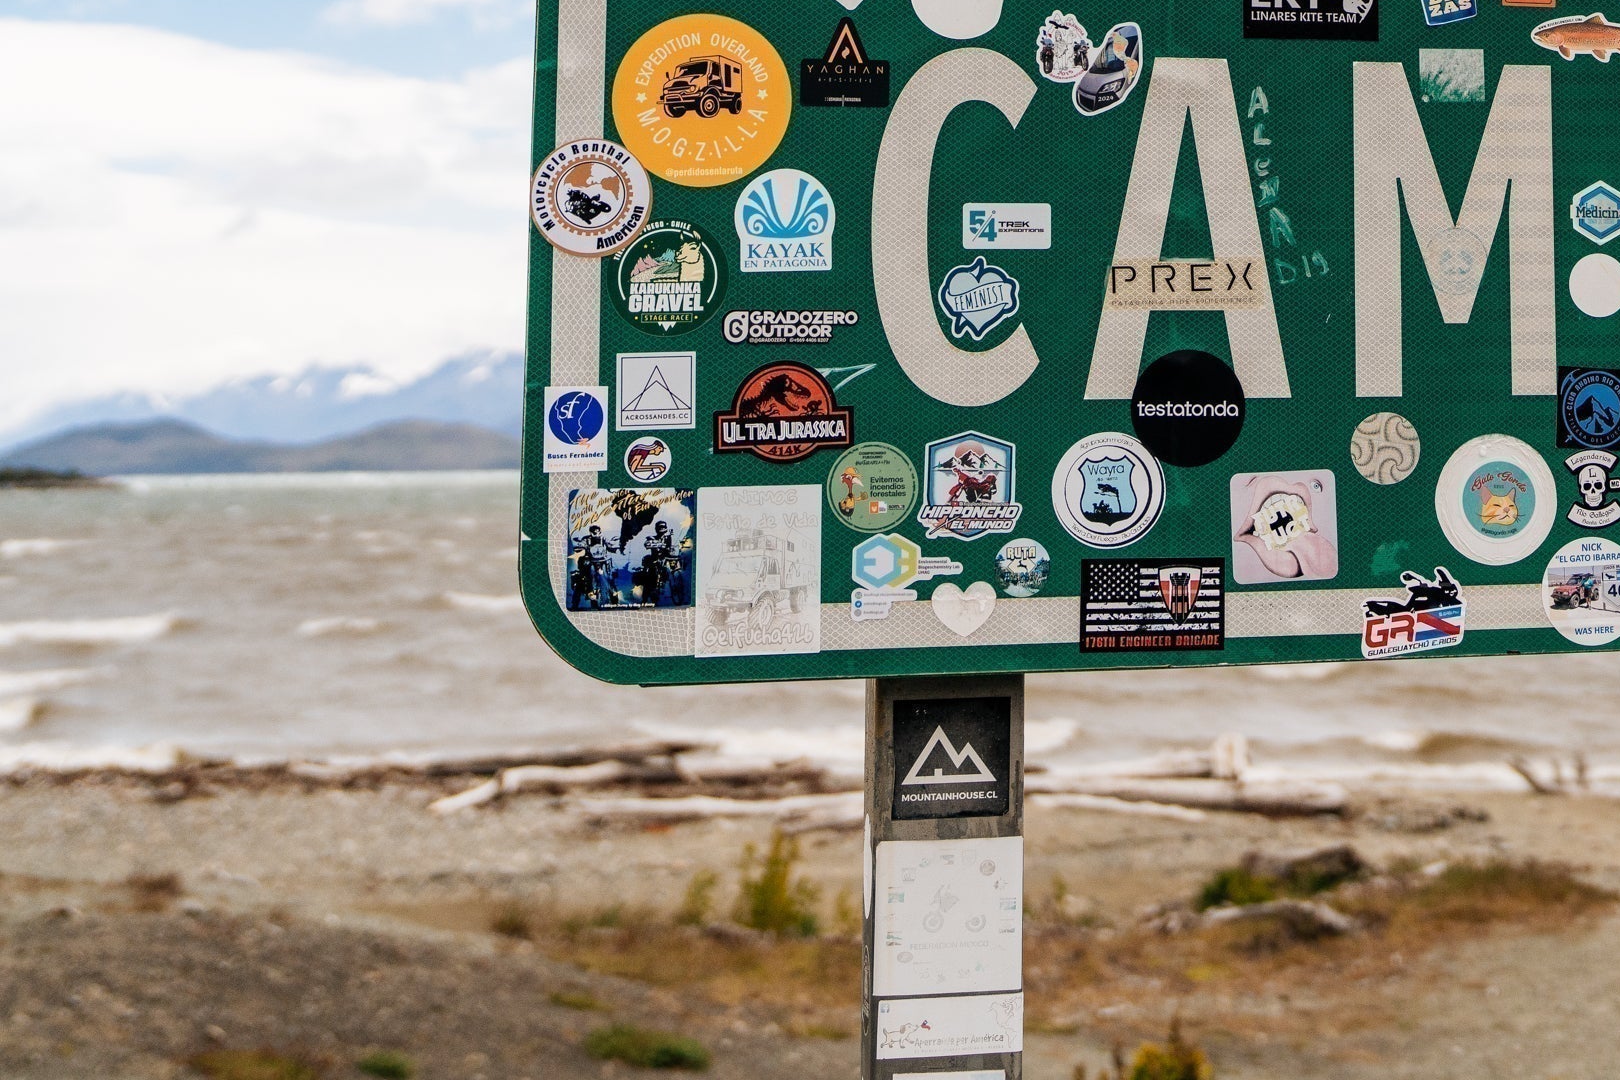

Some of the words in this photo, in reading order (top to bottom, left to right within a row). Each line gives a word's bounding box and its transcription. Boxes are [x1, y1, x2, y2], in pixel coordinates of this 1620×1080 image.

[1251, 11, 1297, 21] LINARES
[1300, 12, 1324, 22] KITE
[1326, 13, 1357, 23] TEAM
[635, 32, 701, 87] EXPEDITION
[710, 33, 769, 83] OVERLAND
[535, 151, 566, 232] Motorcycle
[571, 142, 630, 166] Renthal
[596, 205, 644, 250] American
[747, 242, 823, 259] KAYAK
[744, 260, 758, 268] EN
[764, 258, 827, 268] PATAGONIA
[1112, 263, 1253, 293] PREX
[629, 294, 703, 312] GRAVEL
[953, 283, 1005, 312] FEMINIST
[644, 314, 668, 322] STAGE
[748, 324, 832, 337] OUTDOOR
[1566, 392, 1577, 410] CLUB
[1575, 376, 1600, 393] ANDINO
[1602, 376, 1614, 386] RIO
[1137, 400, 1239, 418] testatonda
[625, 412, 689, 421] ACROSSANDES.CC
[547, 451, 567, 460] Buses
[569, 450, 604, 460] Fernández
[870, 490, 906, 498] forestales
[951, 521, 963, 529] EL
[968, 520, 1012, 529] MUNDO
[1006, 546, 1036, 560] RUTA
[1581, 543, 1602, 552] NICK
[1574, 626, 1595, 635] WAS
[1596, 625, 1614, 635] HERE
[1085, 636, 1115, 648] 176TH
[1120, 636, 1171, 648] ENGINEER
[1176, 634, 1220, 646] BRIGADE
[901, 791, 998, 802] MOUNTAINHOUSE.CL
